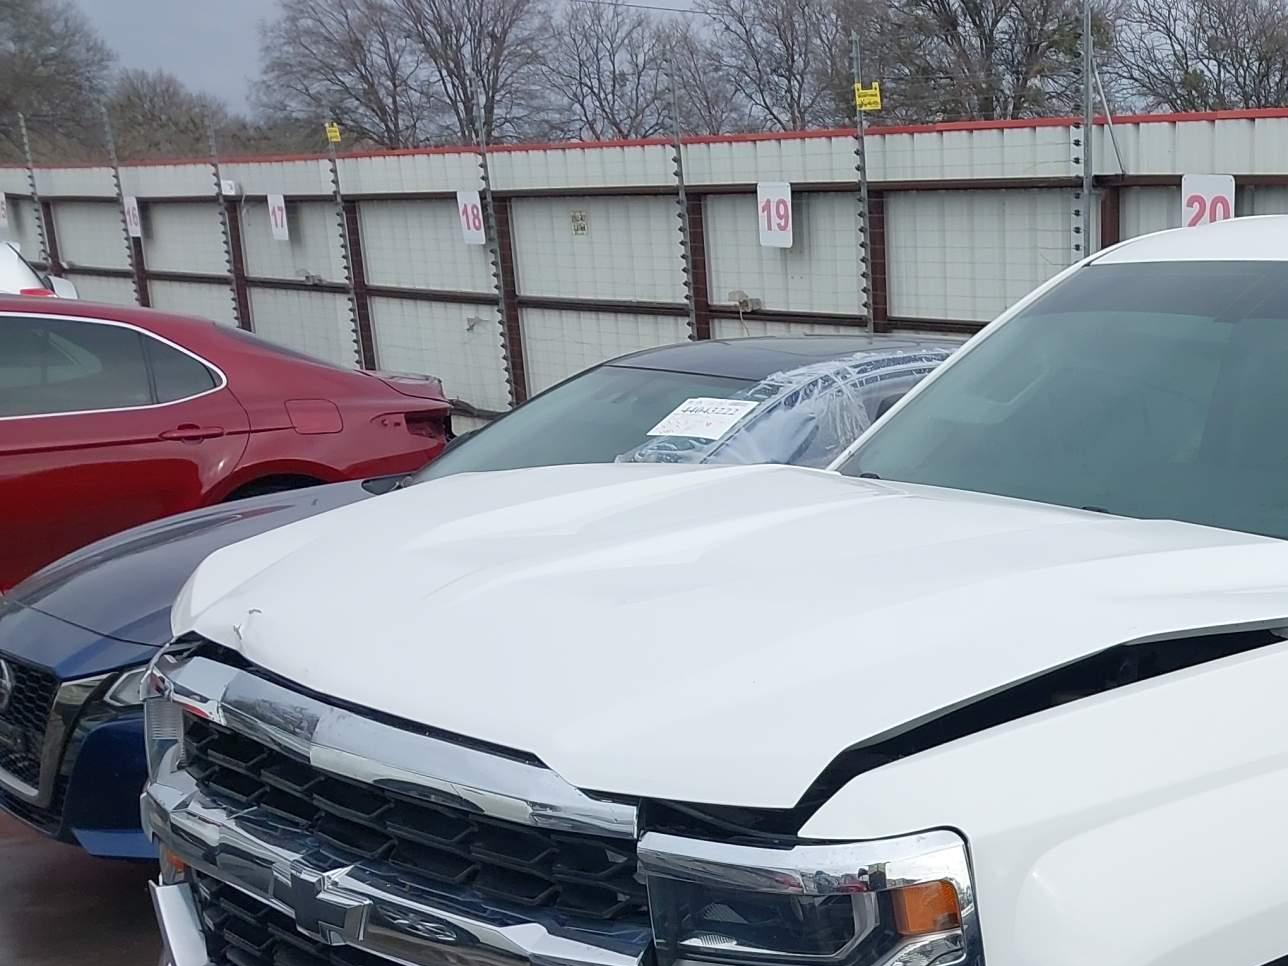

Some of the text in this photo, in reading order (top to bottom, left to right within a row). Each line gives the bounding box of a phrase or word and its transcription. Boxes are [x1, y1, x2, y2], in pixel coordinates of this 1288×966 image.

[126, 206, 140, 226] 16
[271, 205, 284, 229] 17
[461, 203, 482, 231] 18
[761, 198, 790, 232] 19
[1186, 194, 1231, 227] 20
